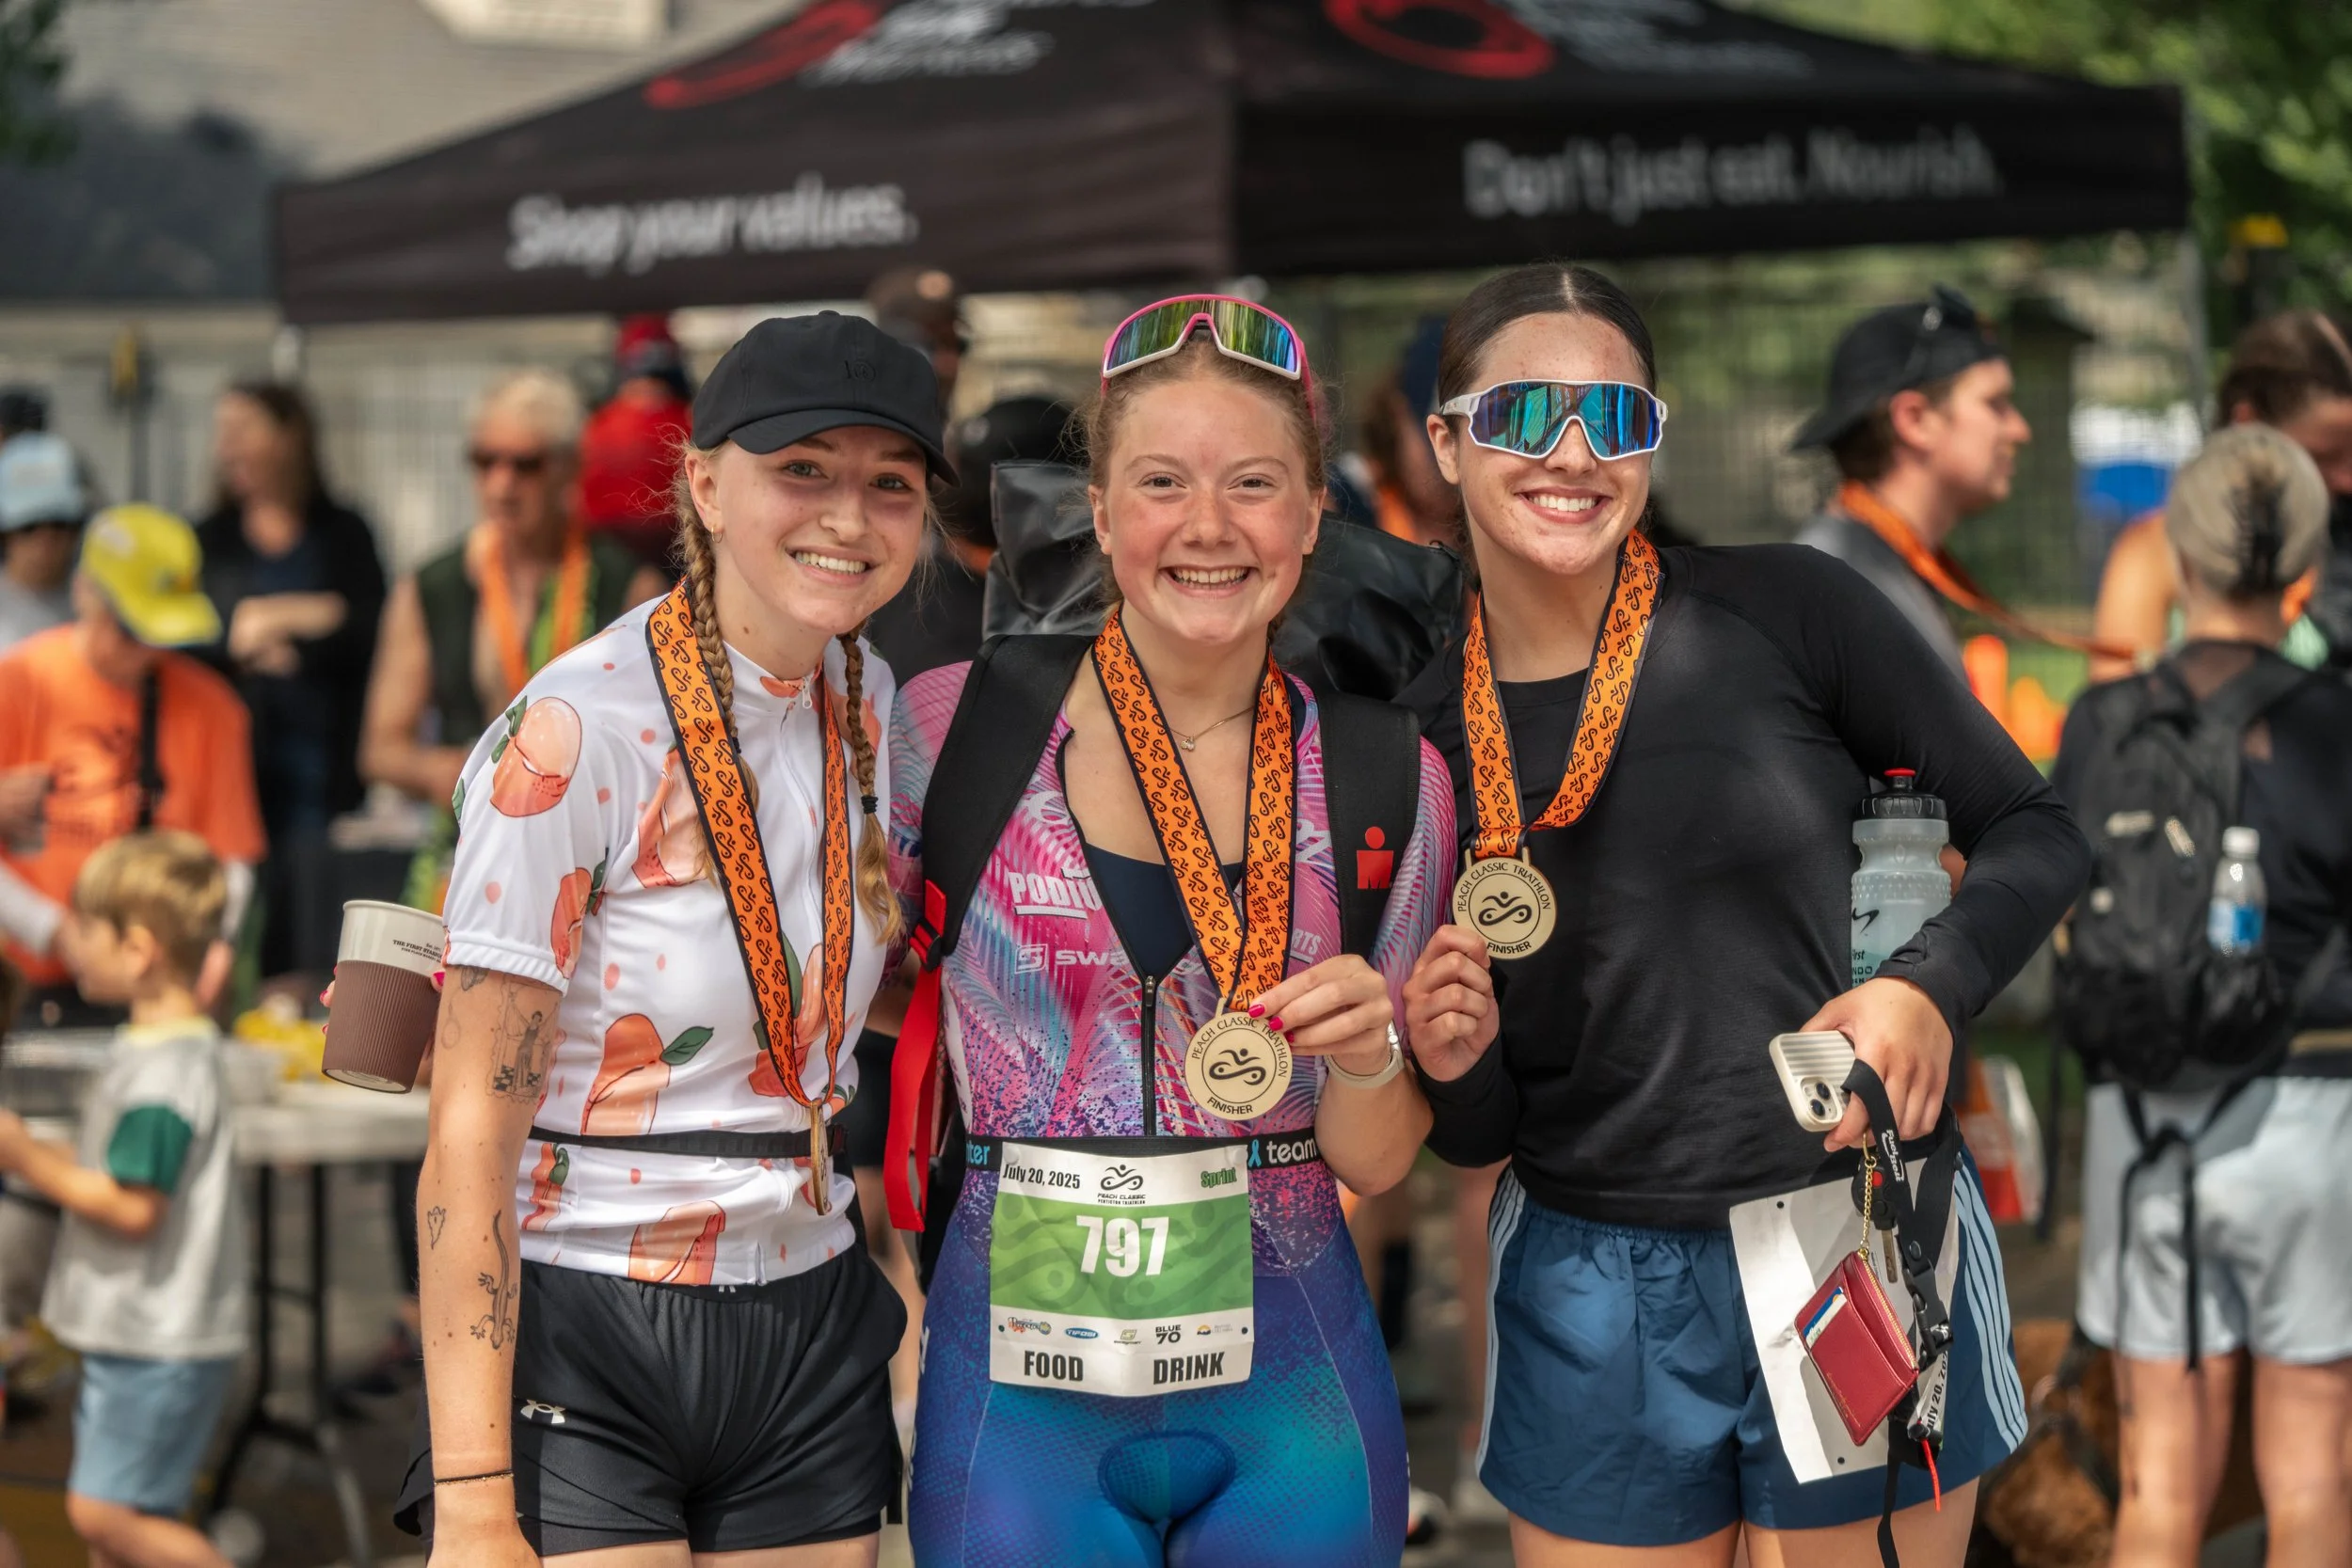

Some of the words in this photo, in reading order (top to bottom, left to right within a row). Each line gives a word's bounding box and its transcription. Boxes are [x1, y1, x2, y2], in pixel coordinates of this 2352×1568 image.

[1609, 132, 1709, 227] just
[505, 192, 625, 278] Shop
[626, 198, 737, 277] your
[739, 170, 919, 251] values.
[1458, 880, 1472, 911] PEACH
[1470, 863, 1508, 880] CLASSIC
[1513, 864, 1550, 910] TRIATHLON
[406, 942, 422, 952] FIRST
[1486, 941, 1532, 954] FINISHER
[1191, 1028, 1216, 1059] PEACH
[1217, 1016, 1259, 1030] CLASSIC
[1262, 1023, 1289, 1077] TRIATHLON
[1207, 1097, 1253, 1115] FINISHER
[1266, 1138, 1317, 1164] team
[1003, 1164, 1026, 1182] July
[1028, 1167, 1045, 1186] 20,
[1048, 1170, 1081, 1189] 2025
[1200, 1167, 1237, 1188] Sprint
[1076, 1214, 1169, 1277] 797
[1155, 1331, 1181, 1344] 70
[1024, 1350, 1083, 1381] FOOD
[1153, 1352, 1224, 1385] DRINK
